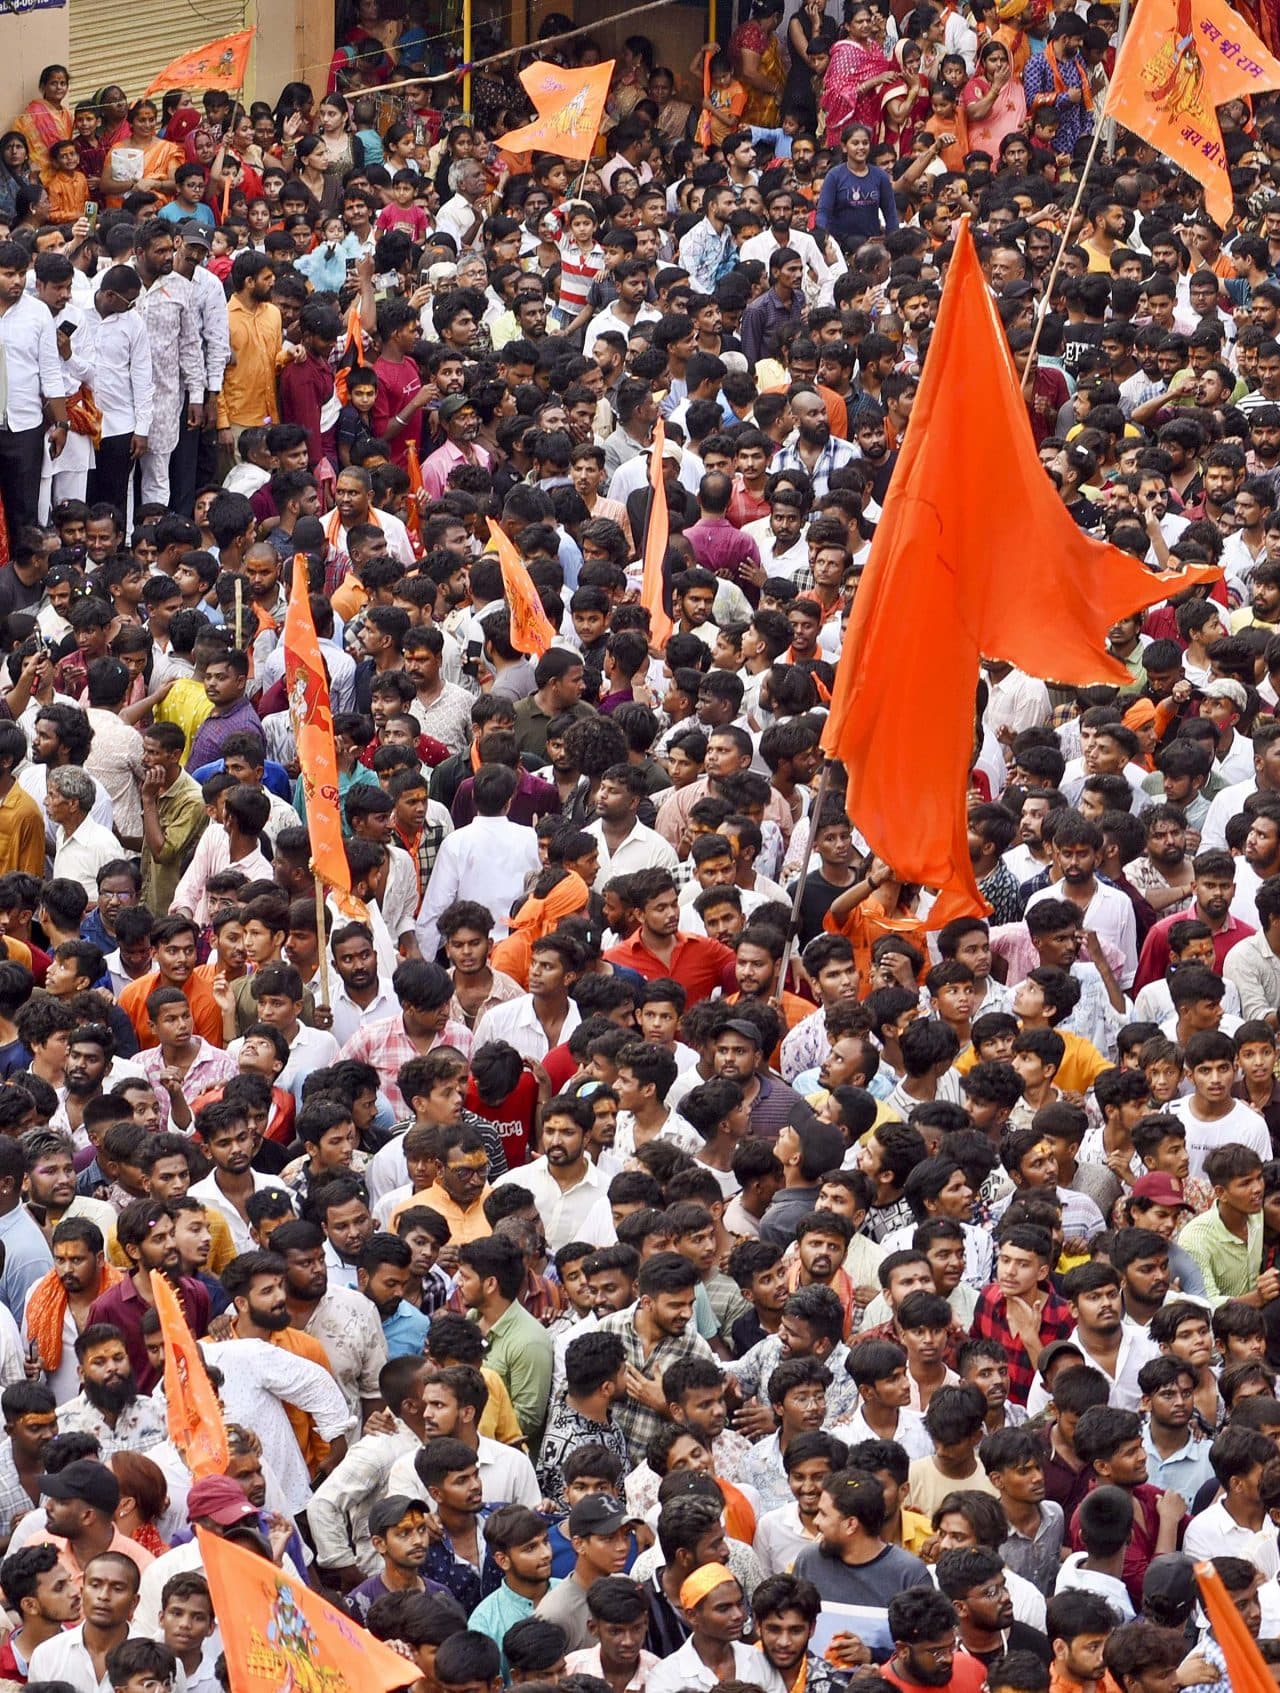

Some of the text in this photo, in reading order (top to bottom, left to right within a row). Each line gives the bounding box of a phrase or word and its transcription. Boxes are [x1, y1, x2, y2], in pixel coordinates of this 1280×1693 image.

[1200, 18, 1265, 79] जय श्री राम
[1181, 125, 1204, 147] जय
